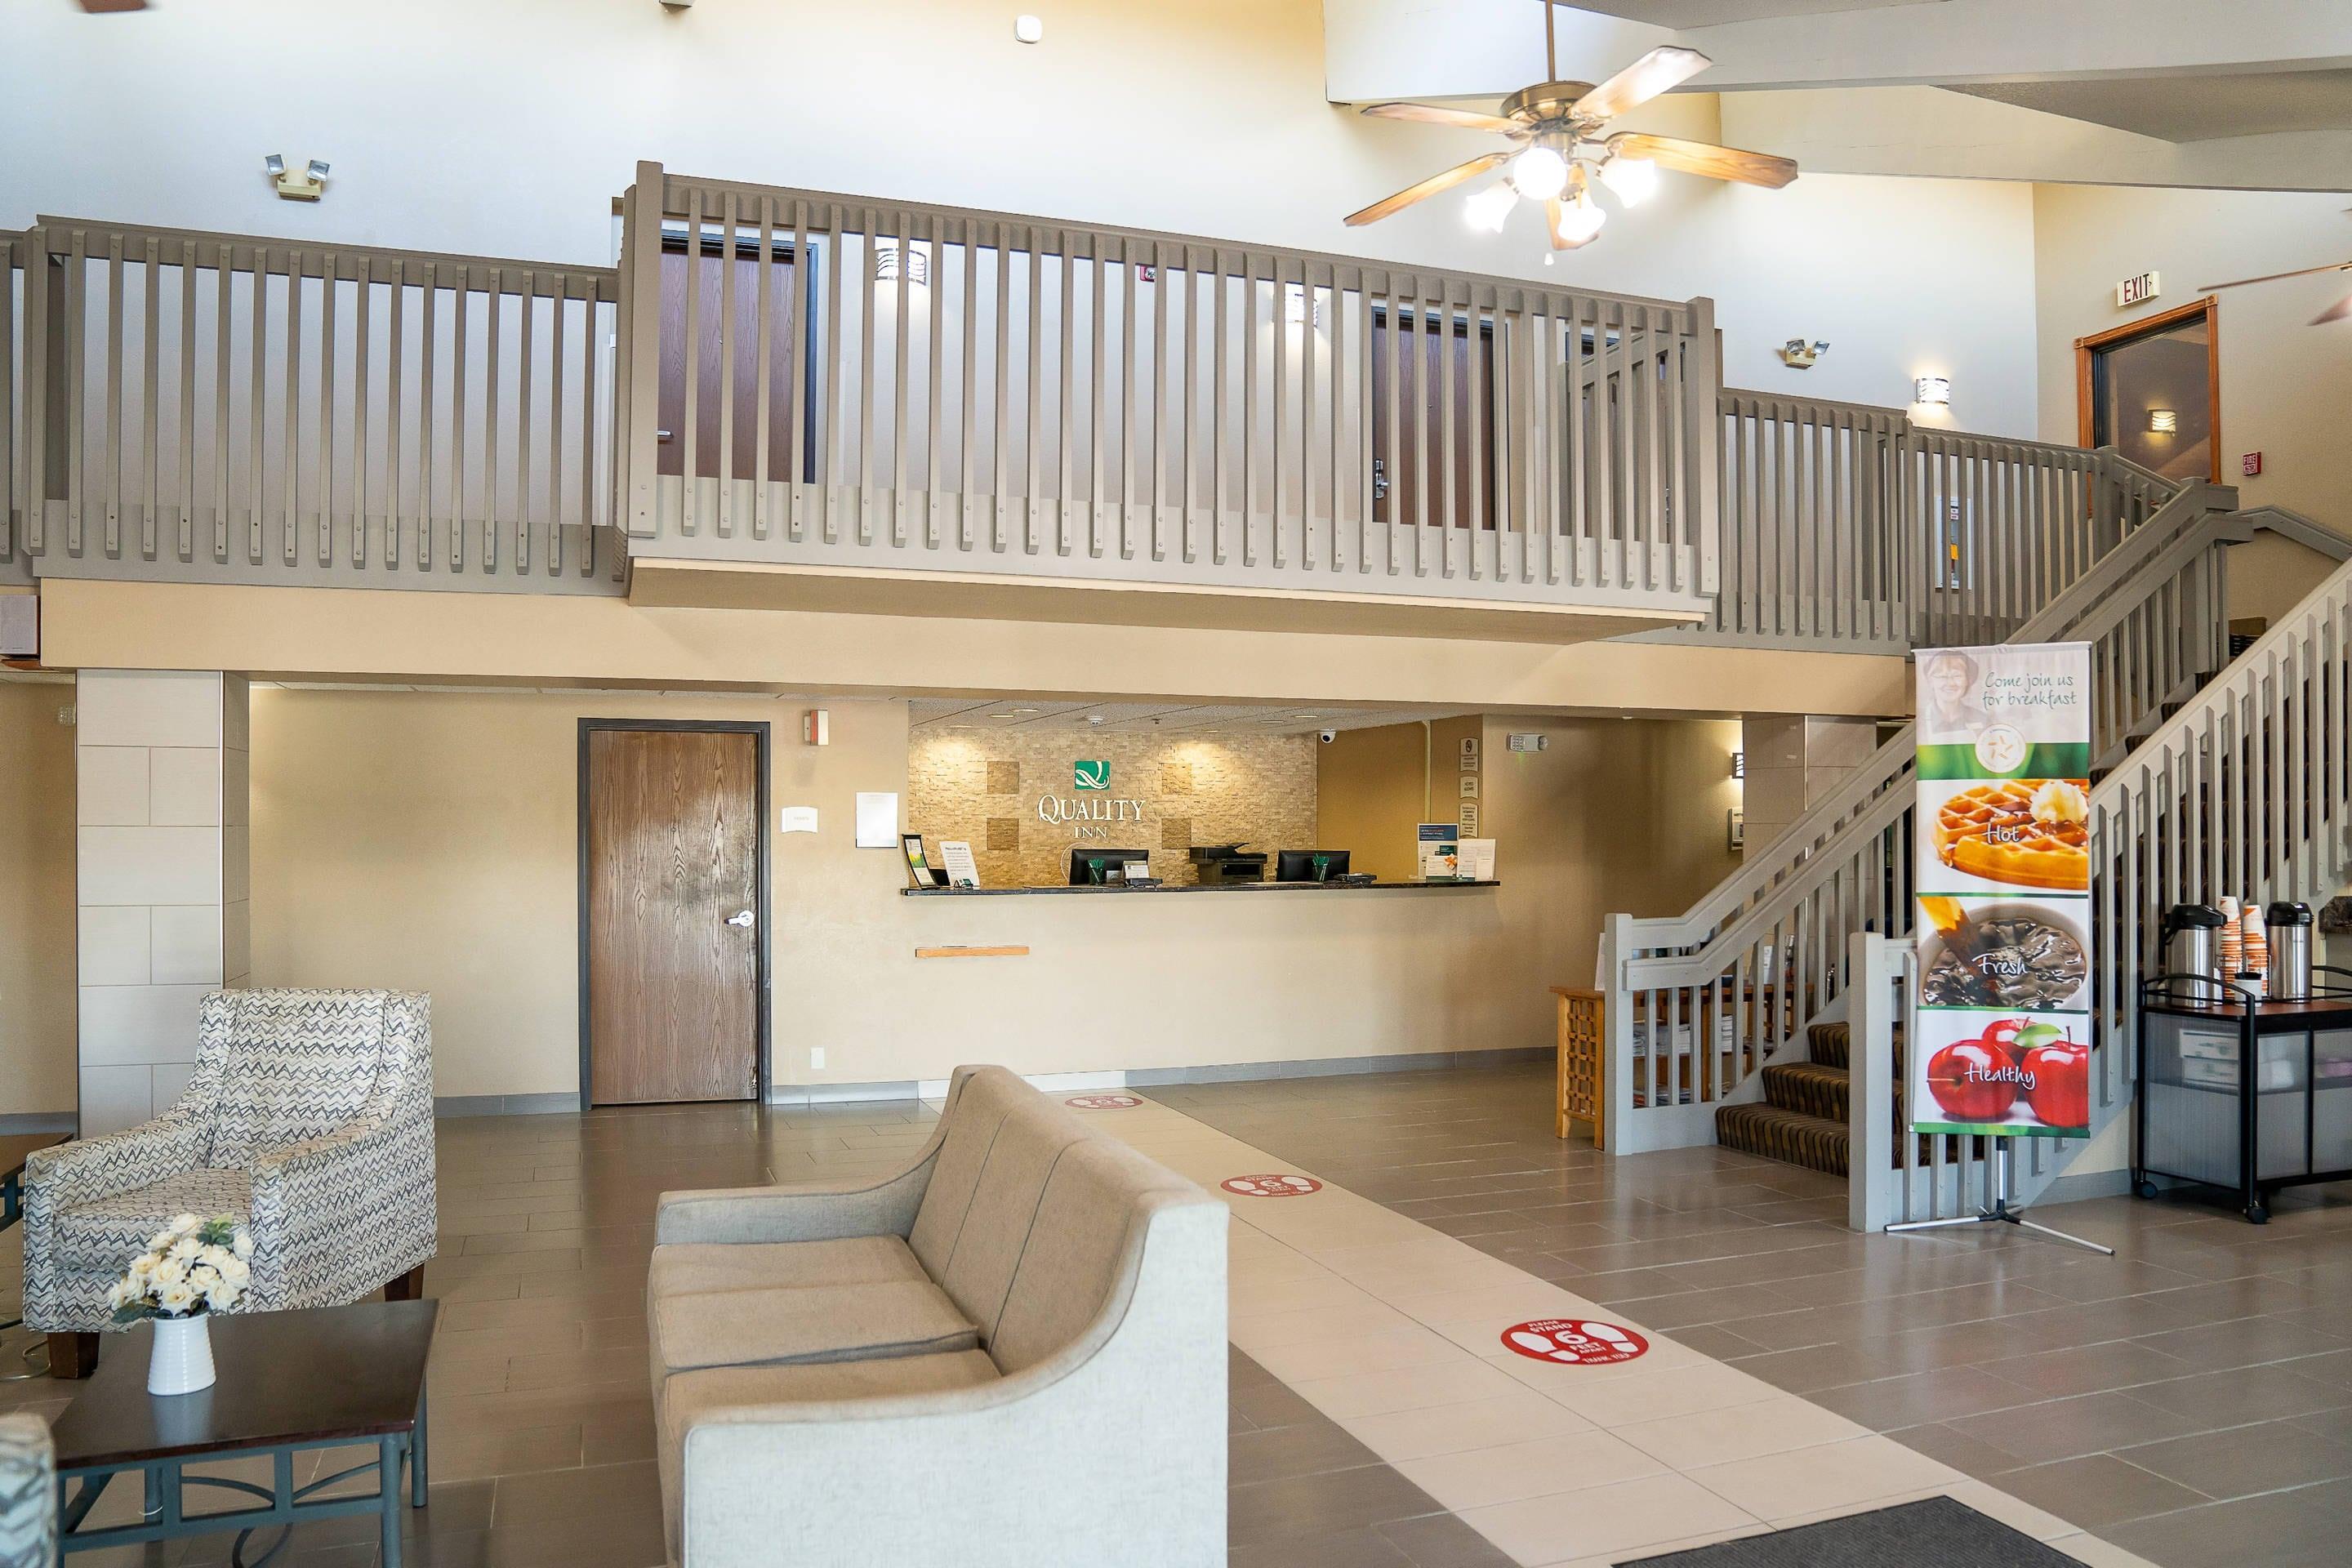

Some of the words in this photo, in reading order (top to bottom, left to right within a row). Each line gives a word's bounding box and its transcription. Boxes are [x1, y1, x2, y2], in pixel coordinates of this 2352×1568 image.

[2123, 273, 2149, 303] EXIT
[1984, 671, 2022, 688] Come
[2025, 674, 2052, 693] join
[2057, 675, 2074, 688] us
[1981, 693, 2004, 710] for
[2007, 693, 2078, 710] breakfast
[1038, 795, 1146, 825] QUALITY
[1074, 826, 1108, 839] INN
[1984, 822, 2020, 845] Hot
[1971, 952, 2029, 975] Fresh
[1963, 1062, 2036, 1090] Healthy
[1529, 1322, 1573, 1334] STAND
[1555, 1330, 1588, 1345] 6
[1569, 1342, 1601, 1352] FEET
[1579, 1346, 1607, 1355] APART
